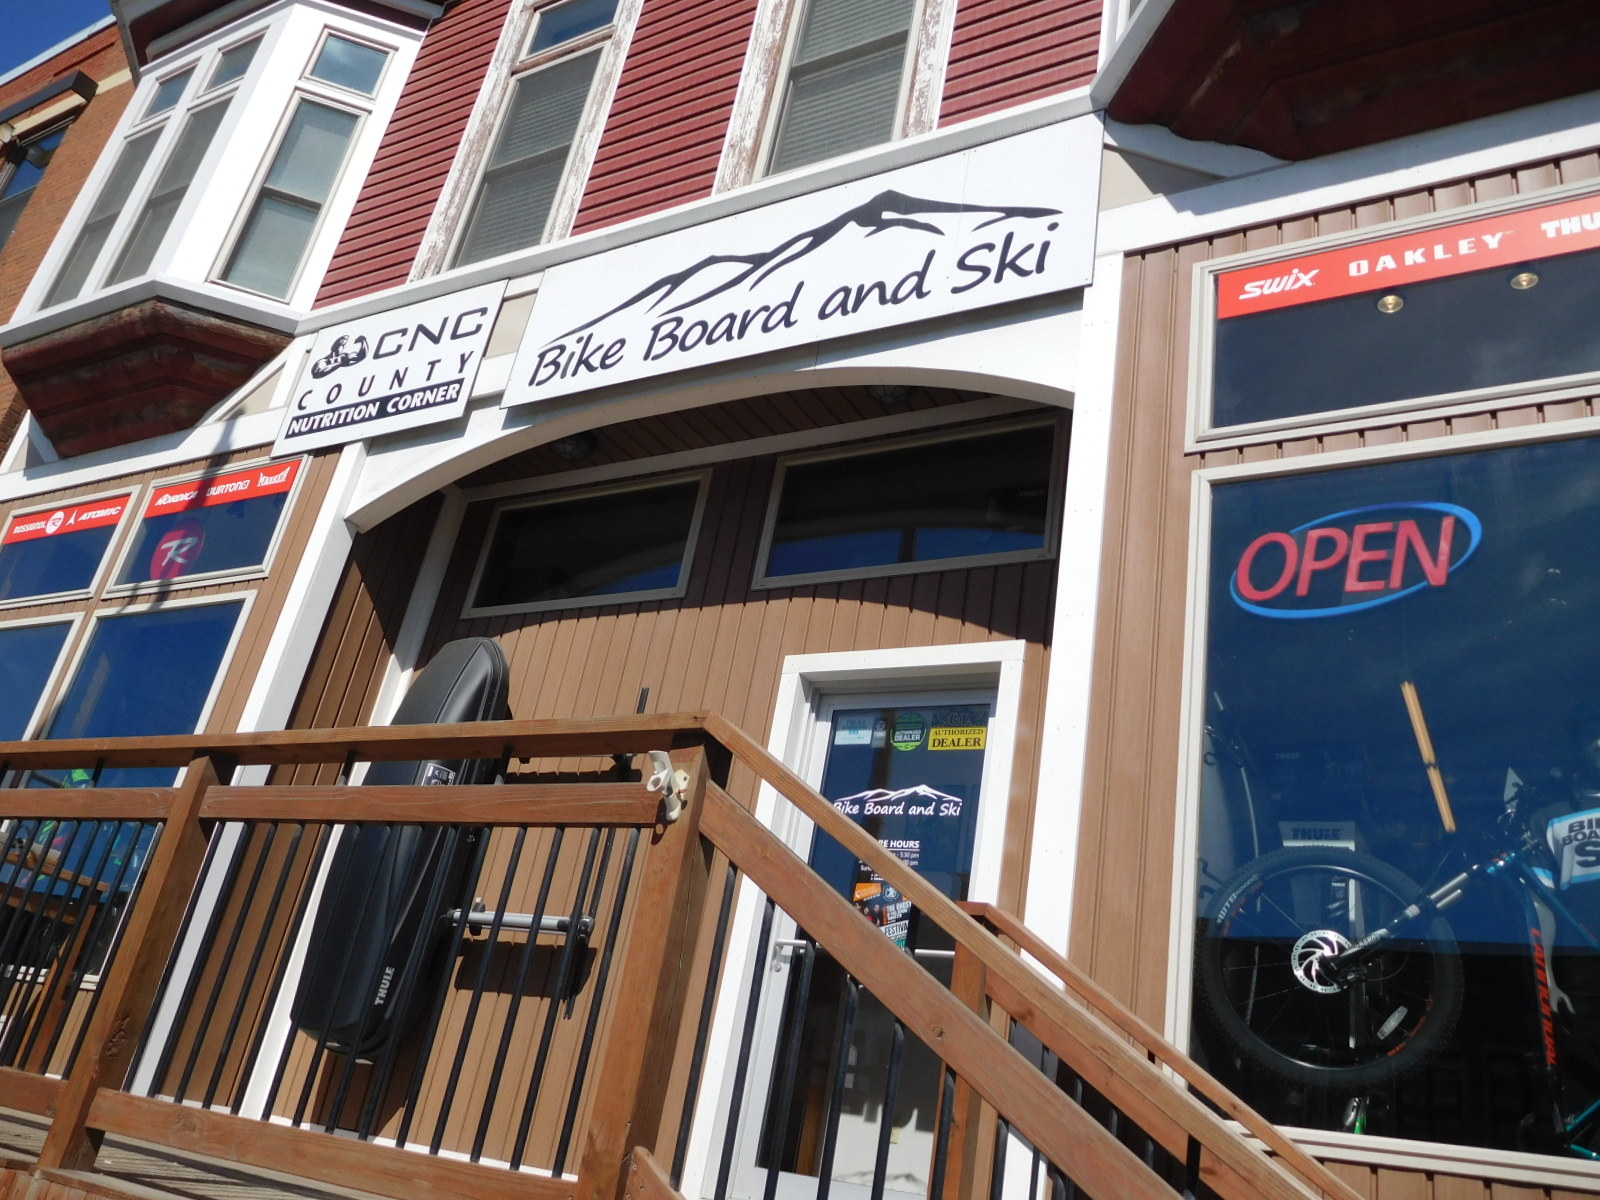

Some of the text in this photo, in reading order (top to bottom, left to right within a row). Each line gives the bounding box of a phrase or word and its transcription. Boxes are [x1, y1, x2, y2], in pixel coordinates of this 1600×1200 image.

[1348, 231, 1506, 277] OAKLEY
[528, 221, 1060, 387] Bike Board and Ski
[372, 306, 488, 360] CNC
[297, 350, 475, 411] COUNTY
[288, 382, 461, 436] NUTRITION CORNER
[206, 482, 241, 497] BURTON
[155, 490, 199, 507] NORDICA
[77, 506, 122, 521] ATOMIC
[1236, 515, 1456, 601] OPEN
[894, 734, 921, 742] DEALER
[934, 728, 984, 737] AUTHORIZED
[931, 737, 982, 748] DEALER
[864, 801, 904, 815] Board
[908, 801, 935, 816] and
[939, 802, 963, 816] Ski
[890, 840, 920, 849] HOURS
[374, 965, 396, 1006] THULE
